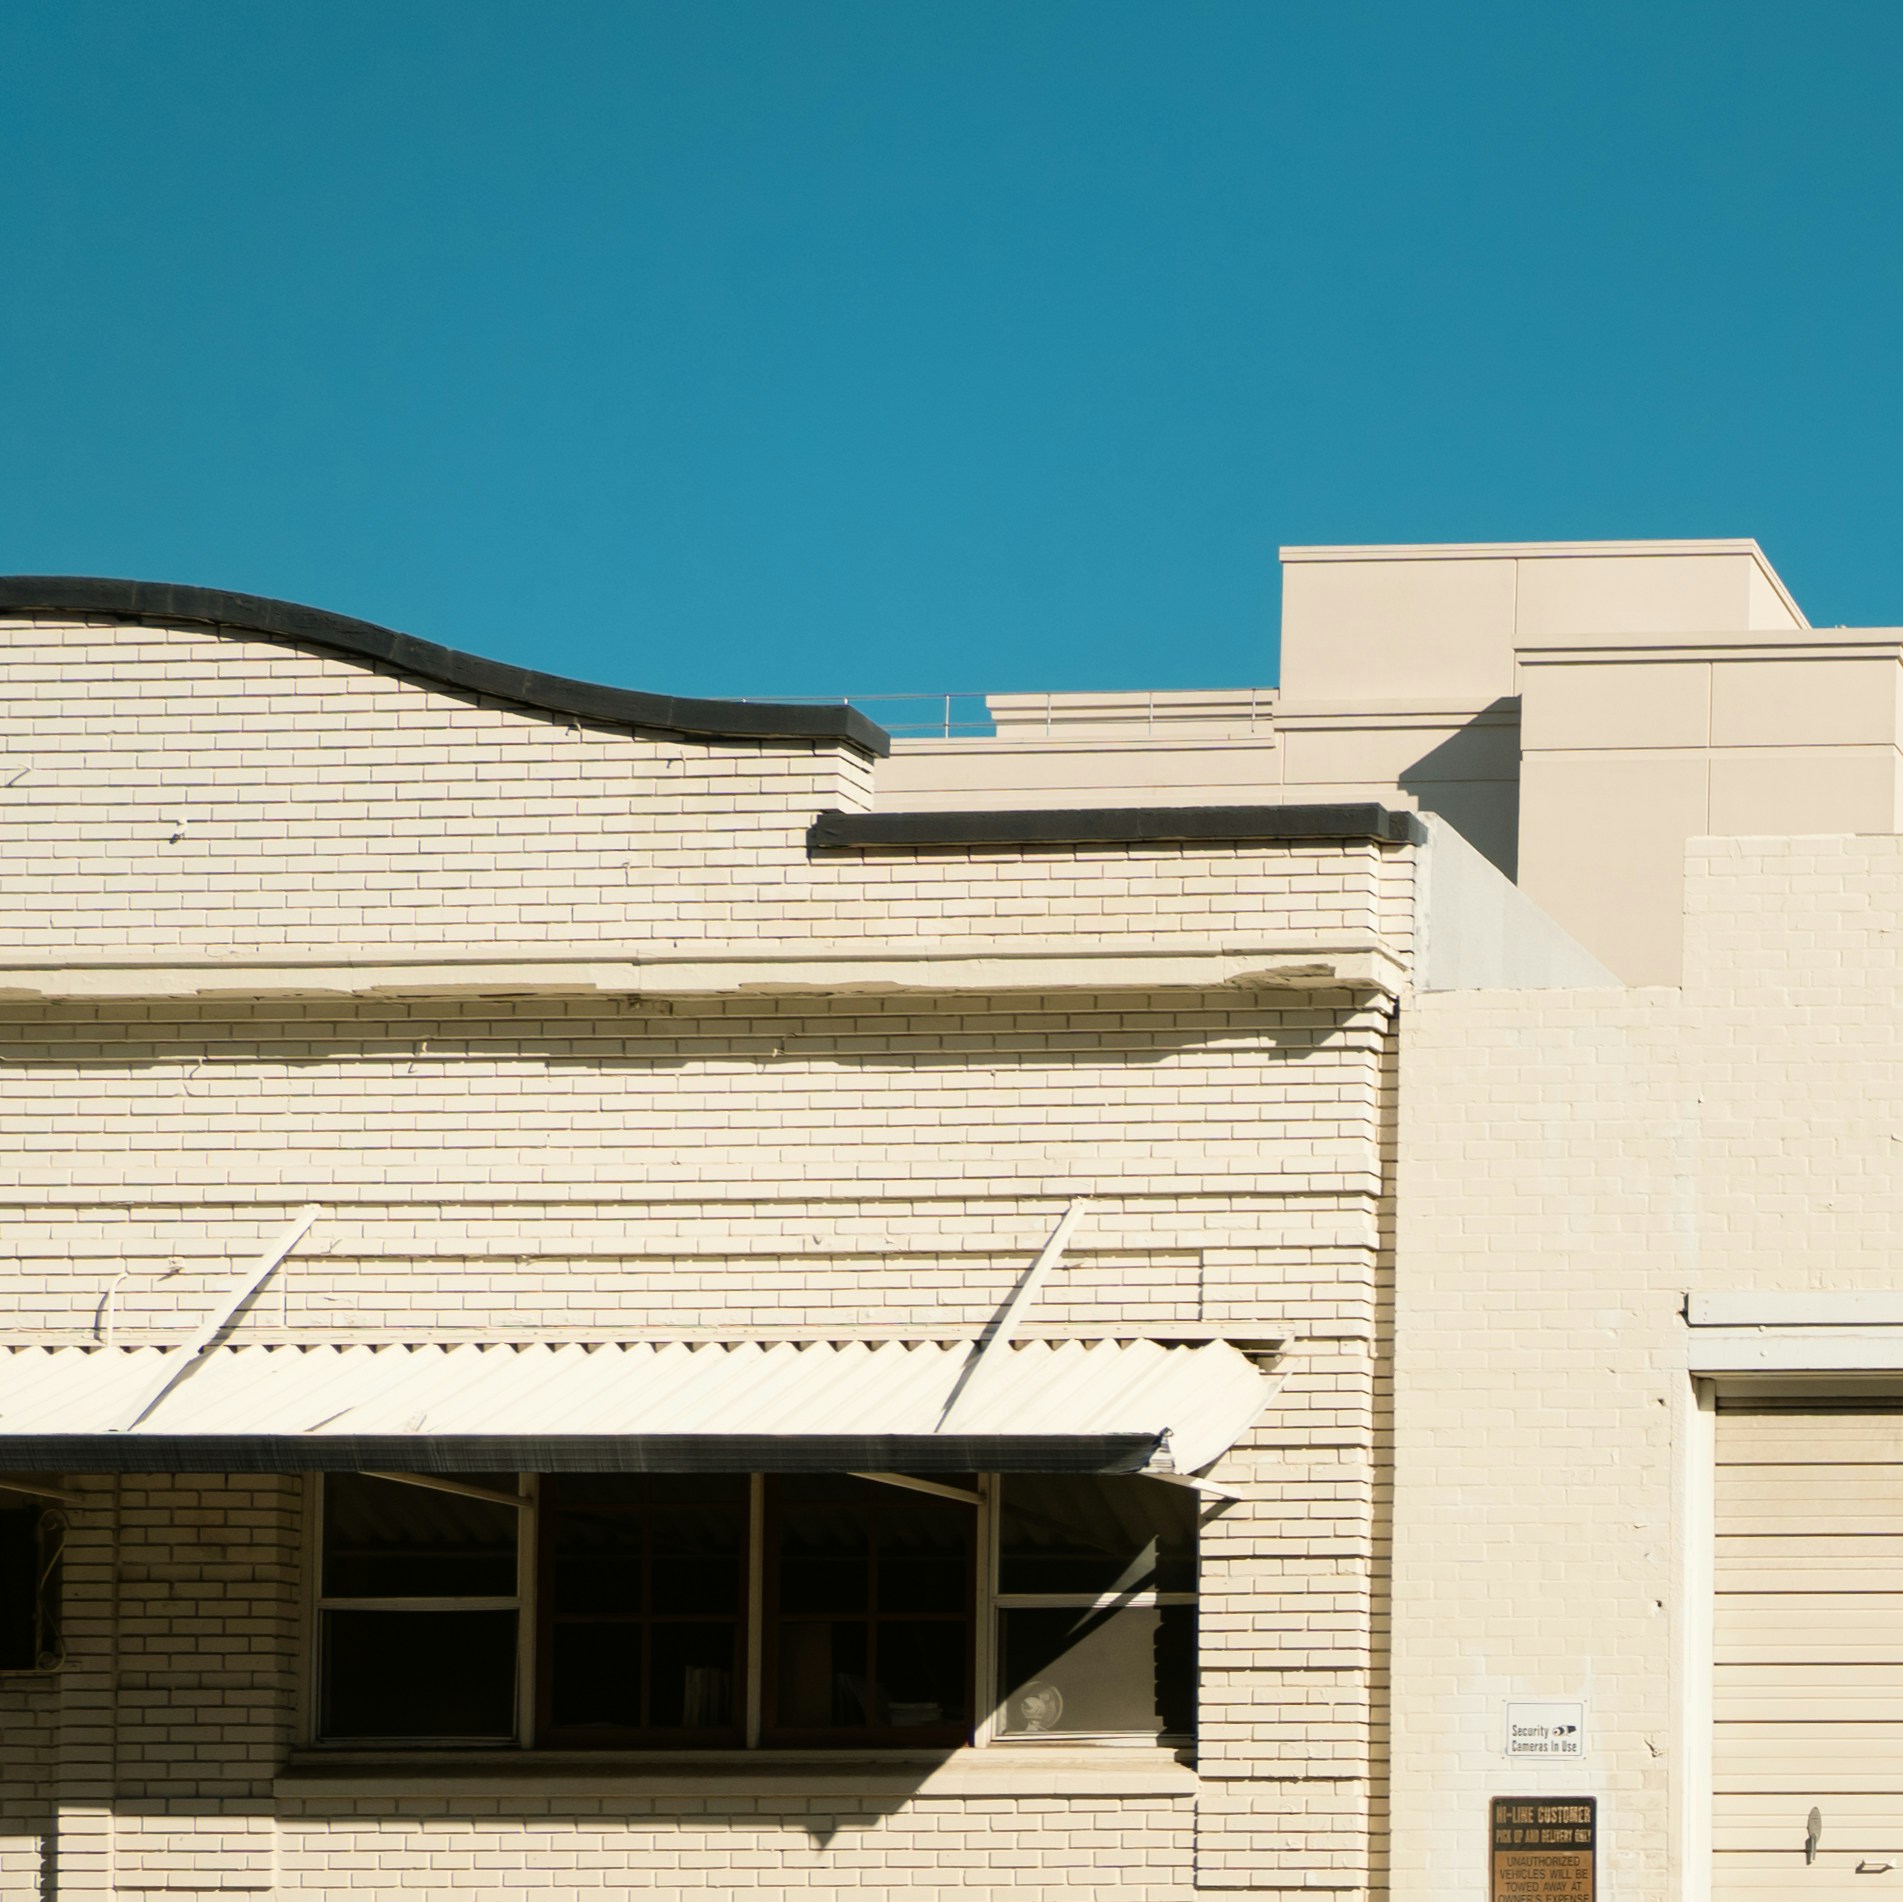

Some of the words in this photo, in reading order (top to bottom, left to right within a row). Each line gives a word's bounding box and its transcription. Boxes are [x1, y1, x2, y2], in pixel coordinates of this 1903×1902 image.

[1512, 1724, 1549, 1739] Security
[1512, 1740, 1549, 1752] Cameras
[1551, 1740, 1559, 1752] In
[1562, 1740, 1577, 1752] Use
[1496, 1806, 1534, 1823] HI-LINE
[1537, 1806, 1591, 1823] CUSTOMER
[1507, 1856, 1580, 1866] UNAUTHORIZED
[1500, 1869, 1545, 1879] VEHICLES
[1550, 1869, 1572, 1879] WILL
[1576, 1869, 1588, 1879] BE
[1505, 1881, 1539, 1892] TOWED
[1543, 1881, 1566, 1892] AWAY
[1571, 1881, 1582, 1892] AT
